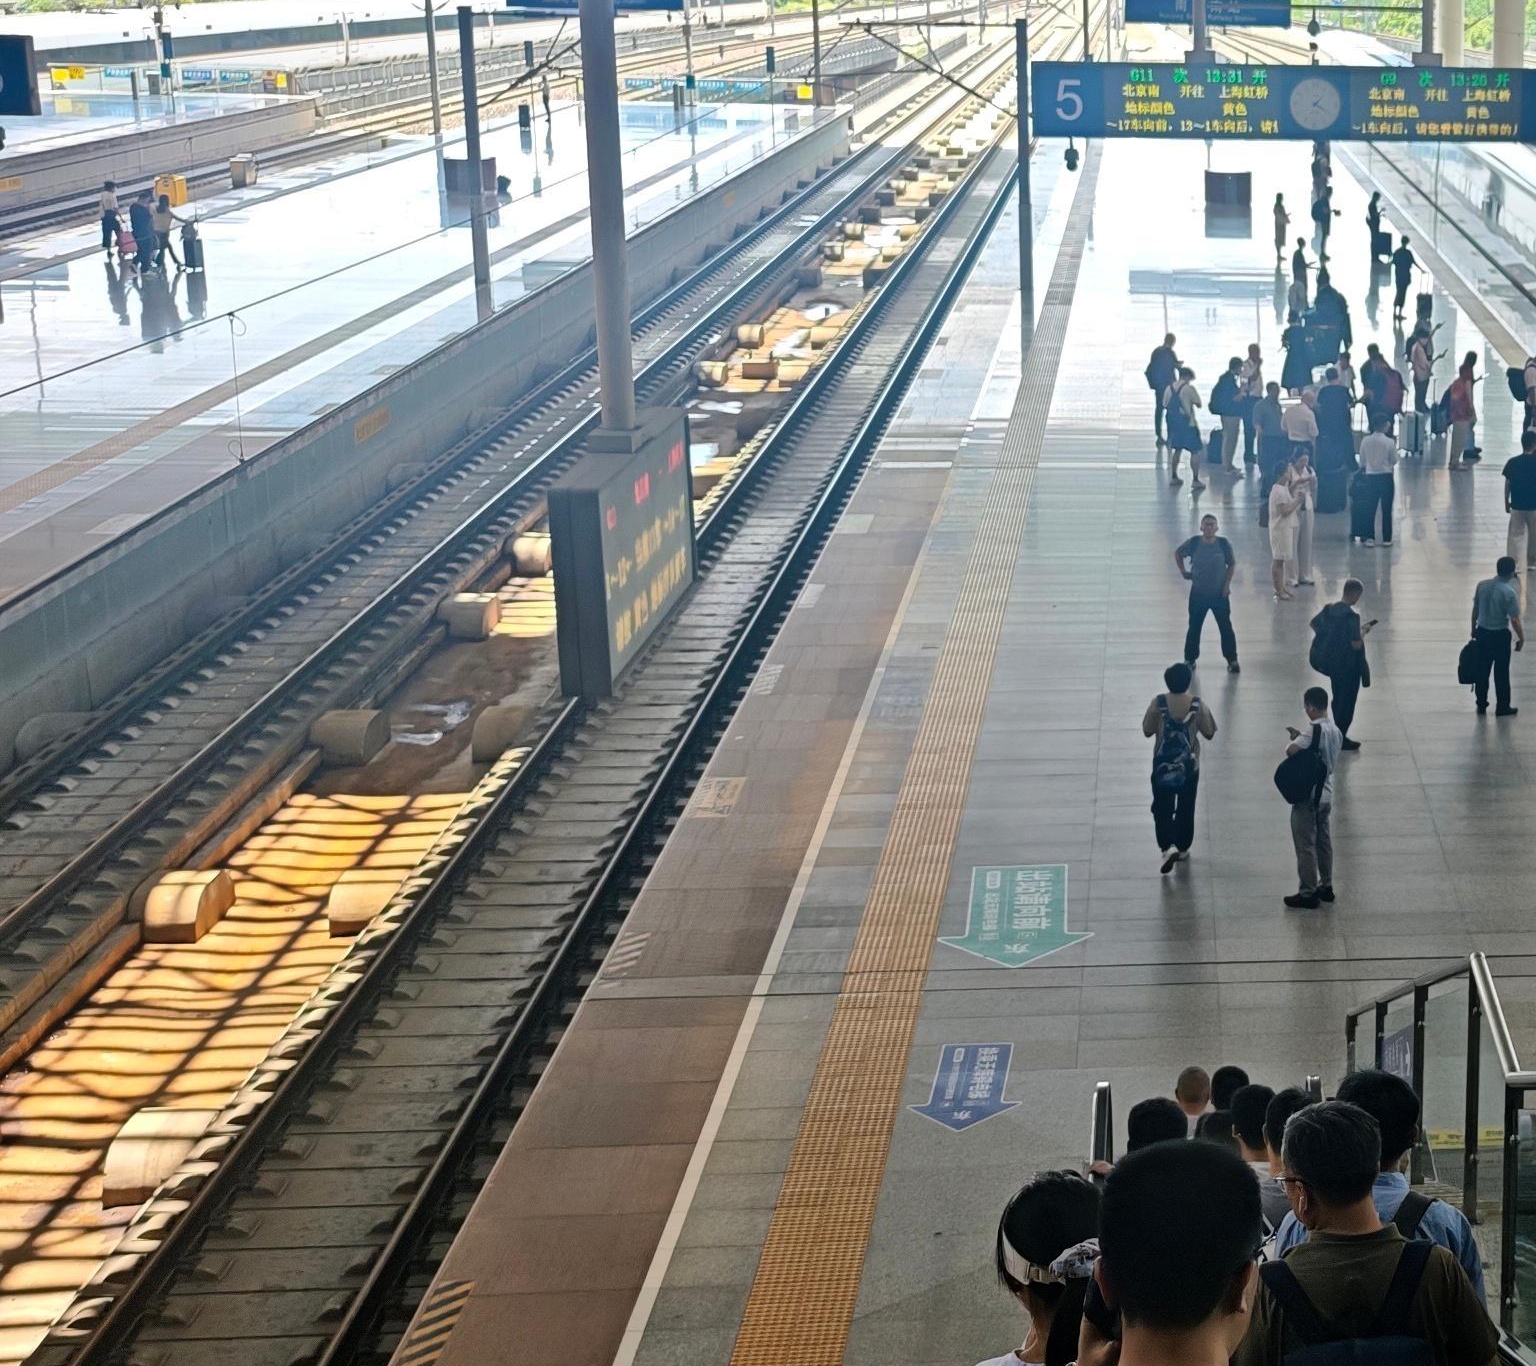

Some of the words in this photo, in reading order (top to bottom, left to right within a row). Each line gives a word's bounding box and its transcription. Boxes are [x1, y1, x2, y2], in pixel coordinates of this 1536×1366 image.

[1129, 68, 1154, 82] G11
[1173, 68, 1189, 84] 次
[1205, 69, 1243, 83] 13:31
[1251, 69, 1268, 85] 开
[1418, 71, 1434, 86] 次
[1495, 73, 1510, 88] 开
[1055, 78, 1084, 122] 5
[1122, 84, 1160, 98] 北京南
[1179, 85, 1205, 99] 开往
[1218, 85, 1269, 100] 上海虹桥
[1368, 87, 1405, 102] 北京南
[1424, 89, 1449, 102] 开往
[1461, 88, 1512, 103] 上海虹桥
[1124, 101, 1176, 116] 地标颜色
[1222, 102, 1248, 116] 黄色
[1370, 105, 1420, 119] 地标颜色
[1466, 106, 1490, 120] 黄色
